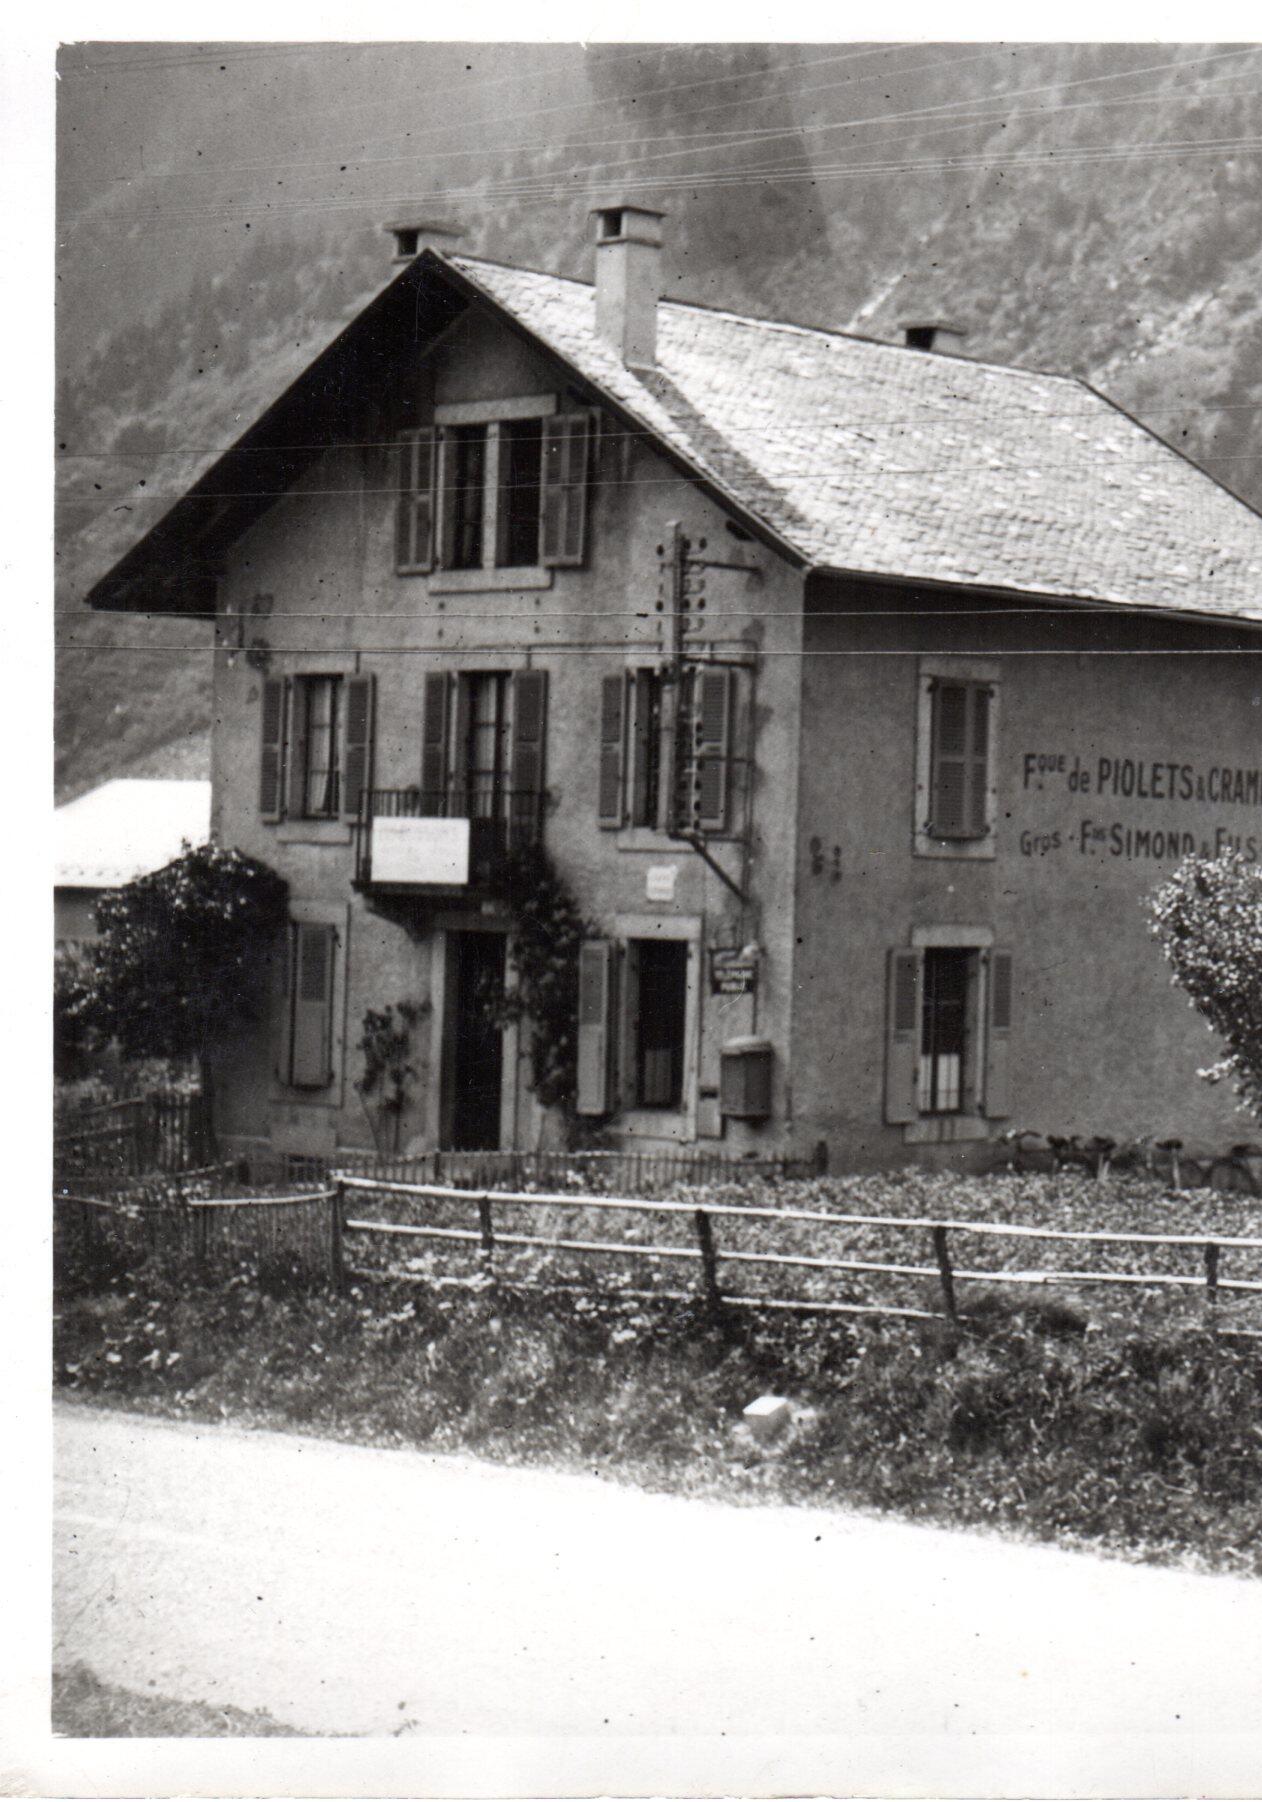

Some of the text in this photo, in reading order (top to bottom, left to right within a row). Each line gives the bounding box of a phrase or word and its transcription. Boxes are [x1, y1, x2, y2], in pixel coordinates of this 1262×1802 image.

[1068, 756, 1091, 794] de
[1097, 757, 1194, 800] PIOLETS
[1110, 822, 1195, 861] SIMOND
